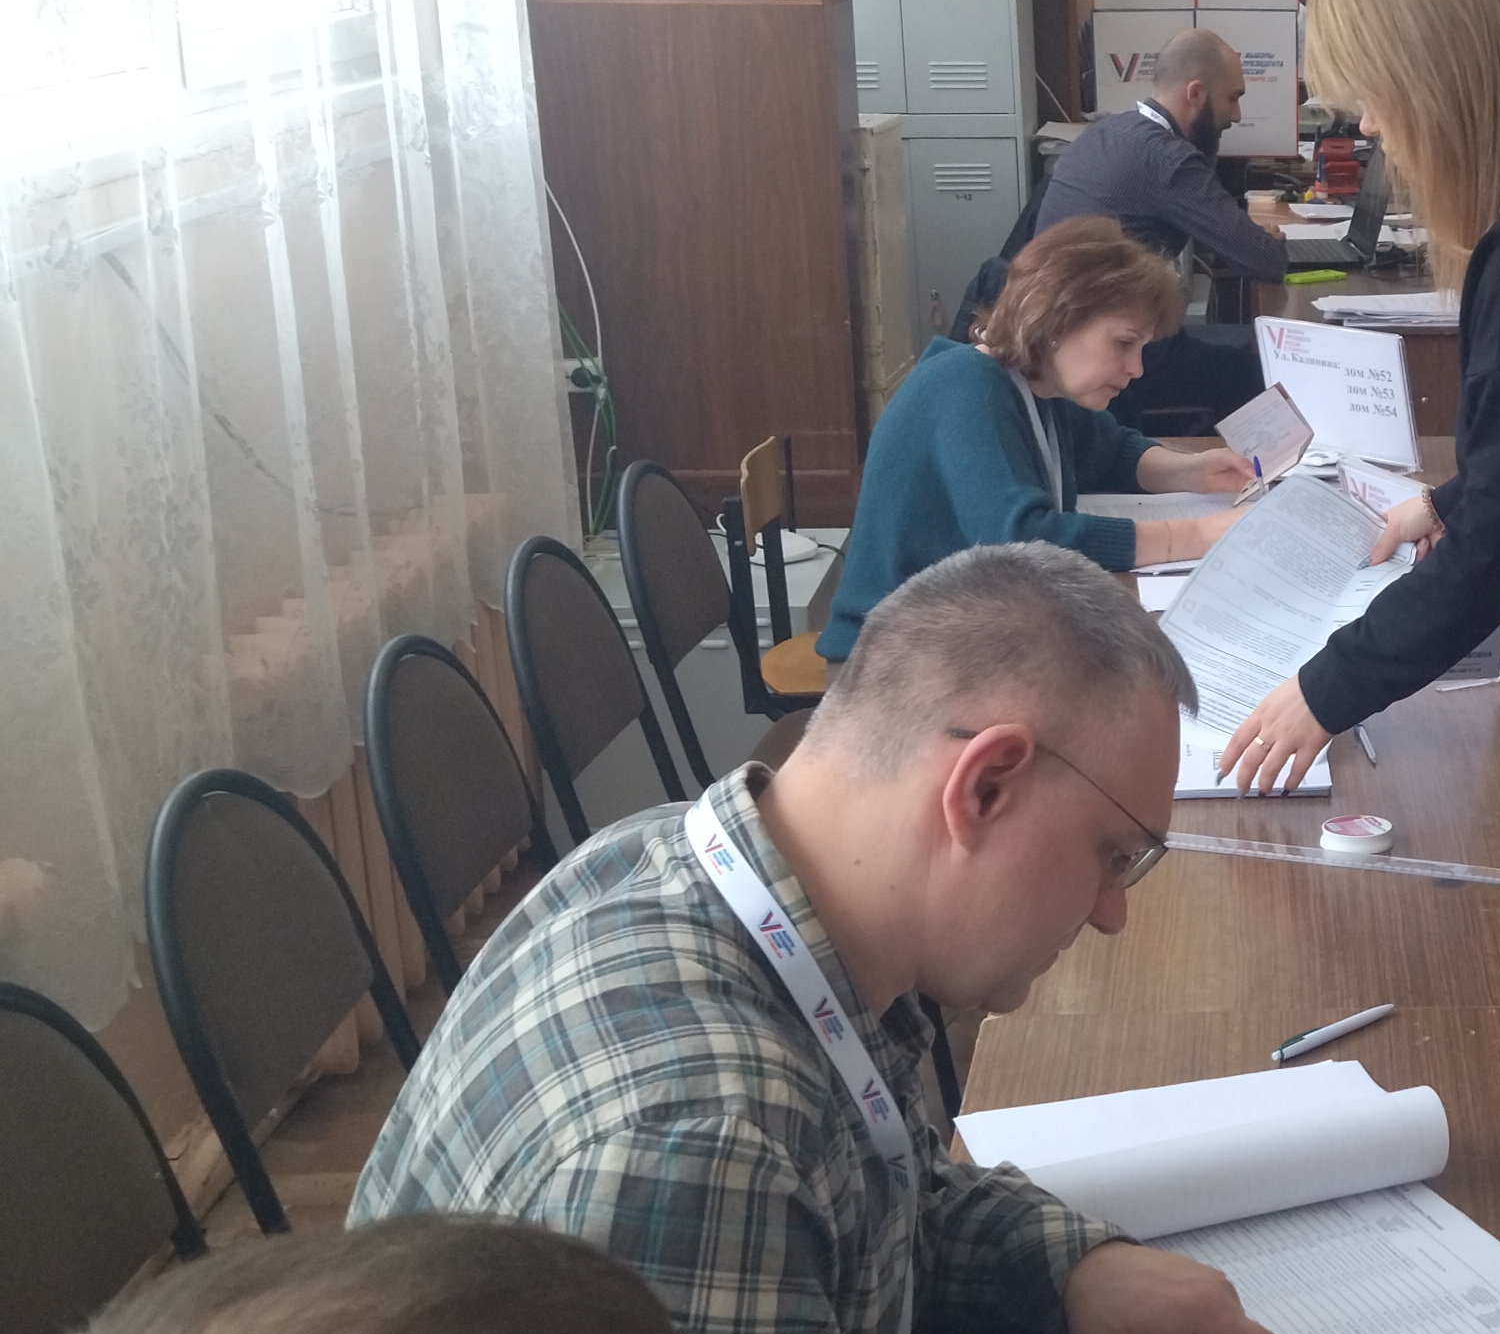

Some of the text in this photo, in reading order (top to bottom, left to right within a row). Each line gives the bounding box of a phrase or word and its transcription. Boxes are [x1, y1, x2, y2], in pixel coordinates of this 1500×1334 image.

[1274, 349, 1341, 369] Ул. Калинина:
[1344, 367, 1393, 382] дом №52
[1347, 385, 1395, 400] дом №53
[1349, 403, 1397, 418] дом №54
